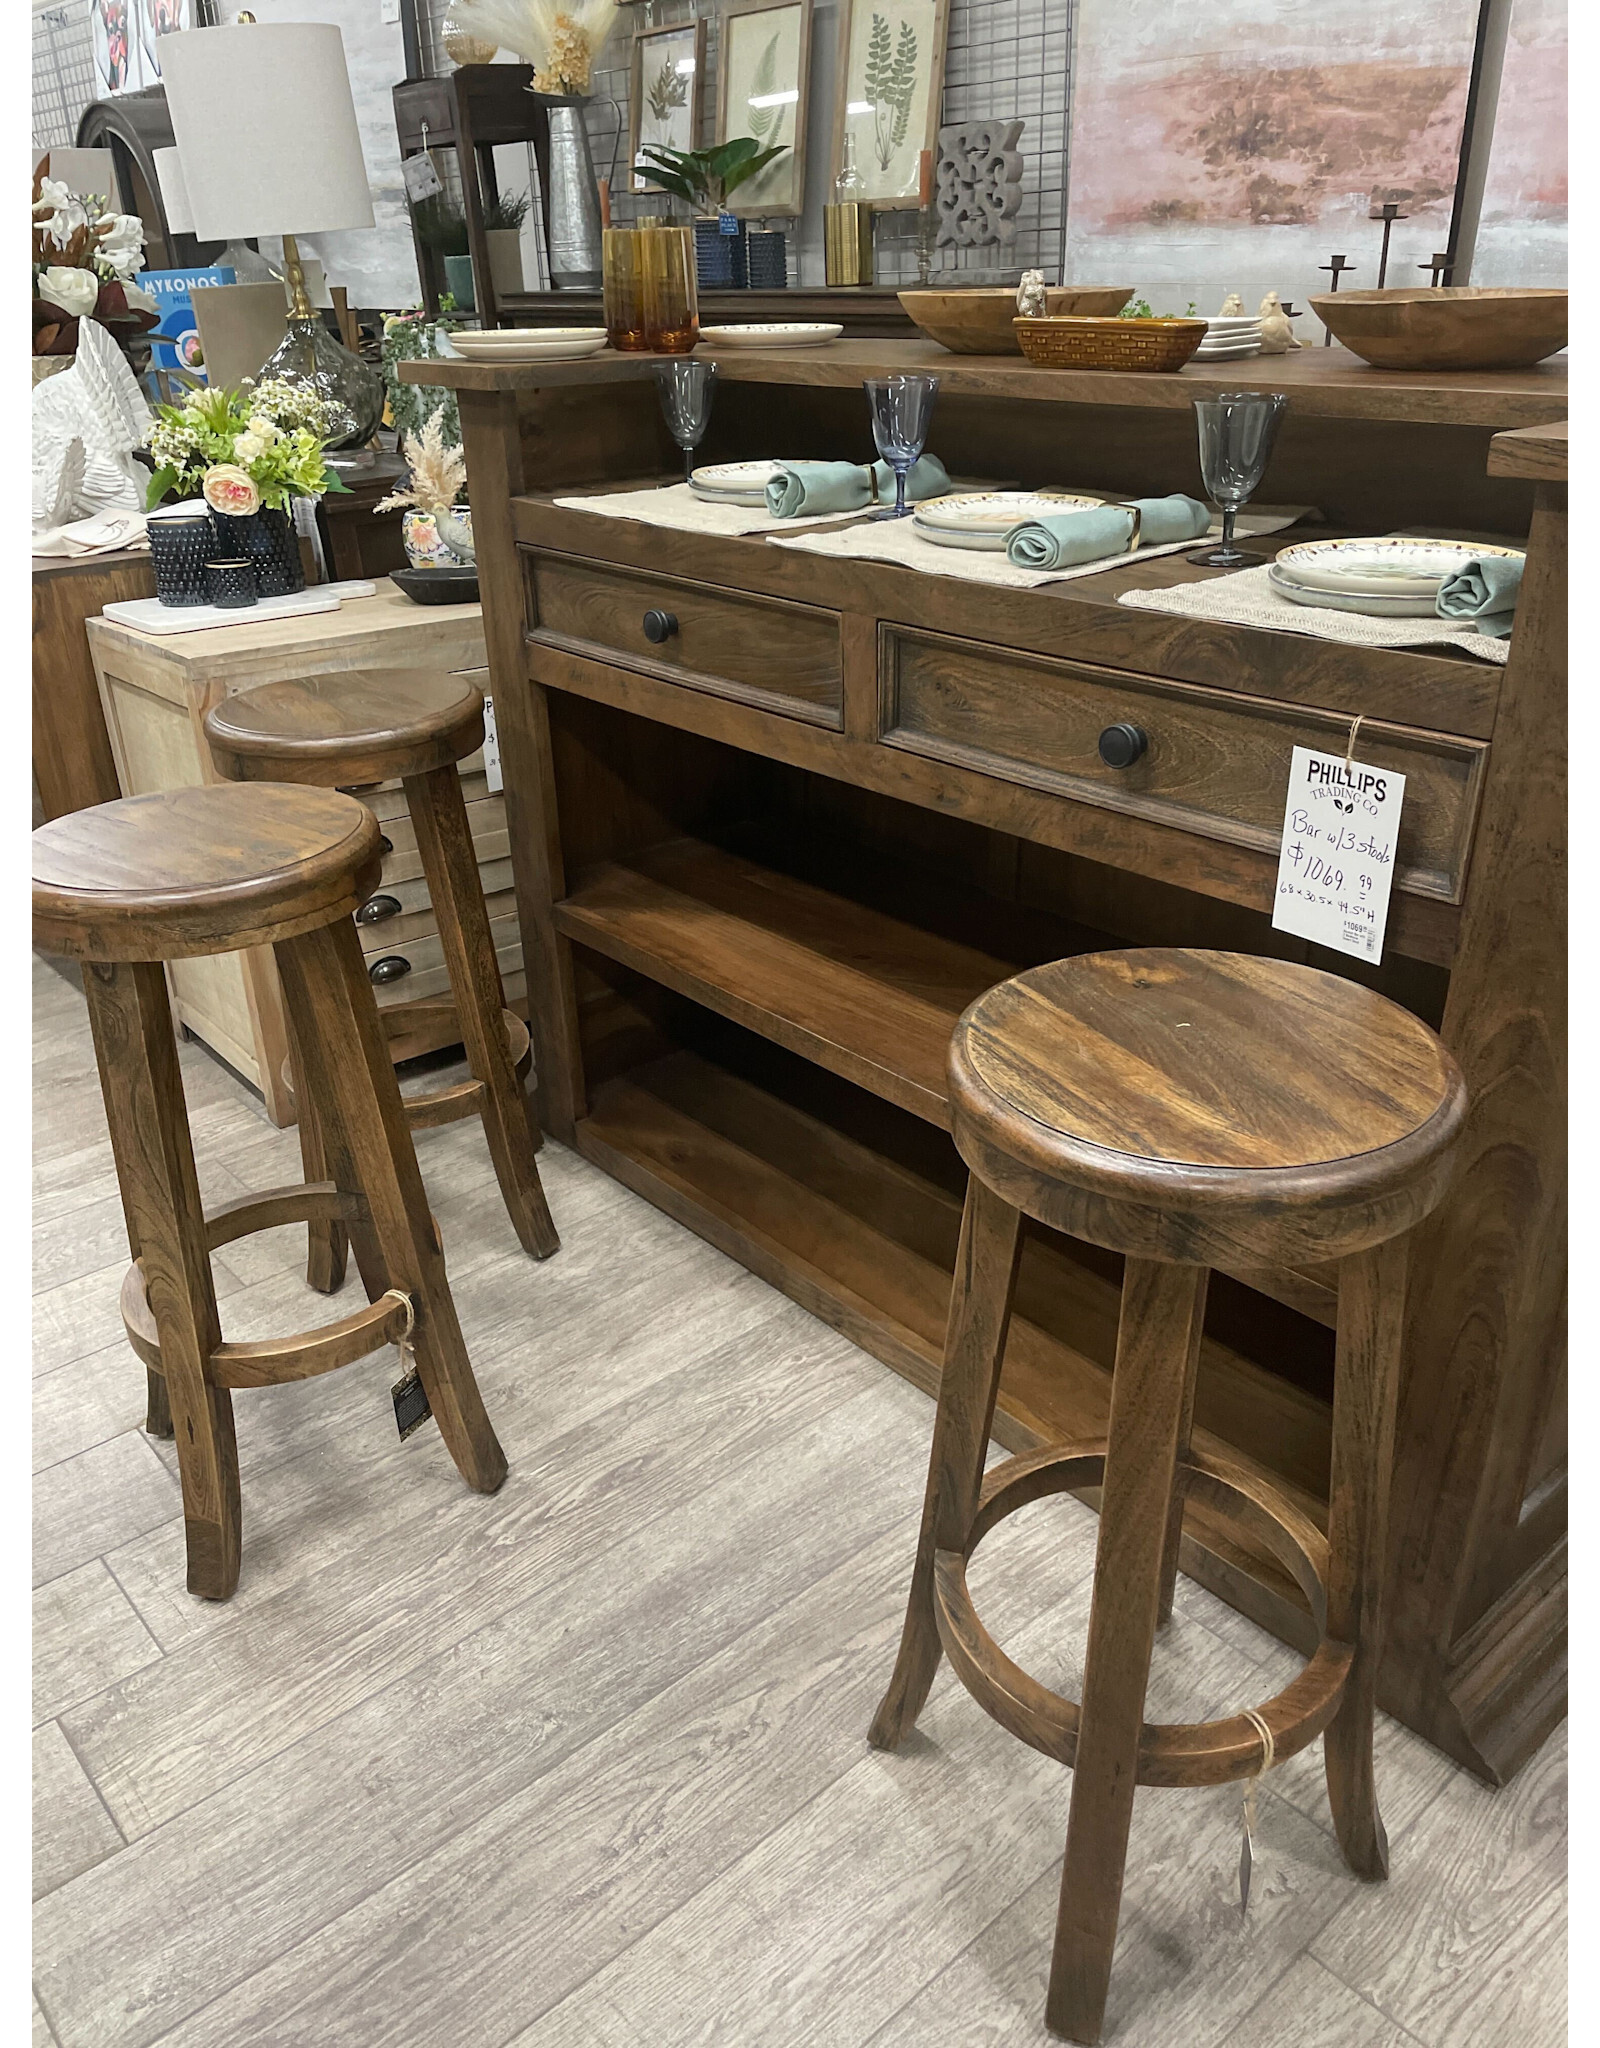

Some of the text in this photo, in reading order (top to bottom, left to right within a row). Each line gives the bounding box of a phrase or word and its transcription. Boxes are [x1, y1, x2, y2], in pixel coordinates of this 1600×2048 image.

[144, 276, 219, 294] MYKONOS
[1307, 759, 1387, 802] PHILLIPS
[1310, 786, 1362, 803] TRADING
[1291, 809, 1322, 838] Bar
[1356, 835, 1390, 863] stools
[1280, 881, 1294, 893] 68
